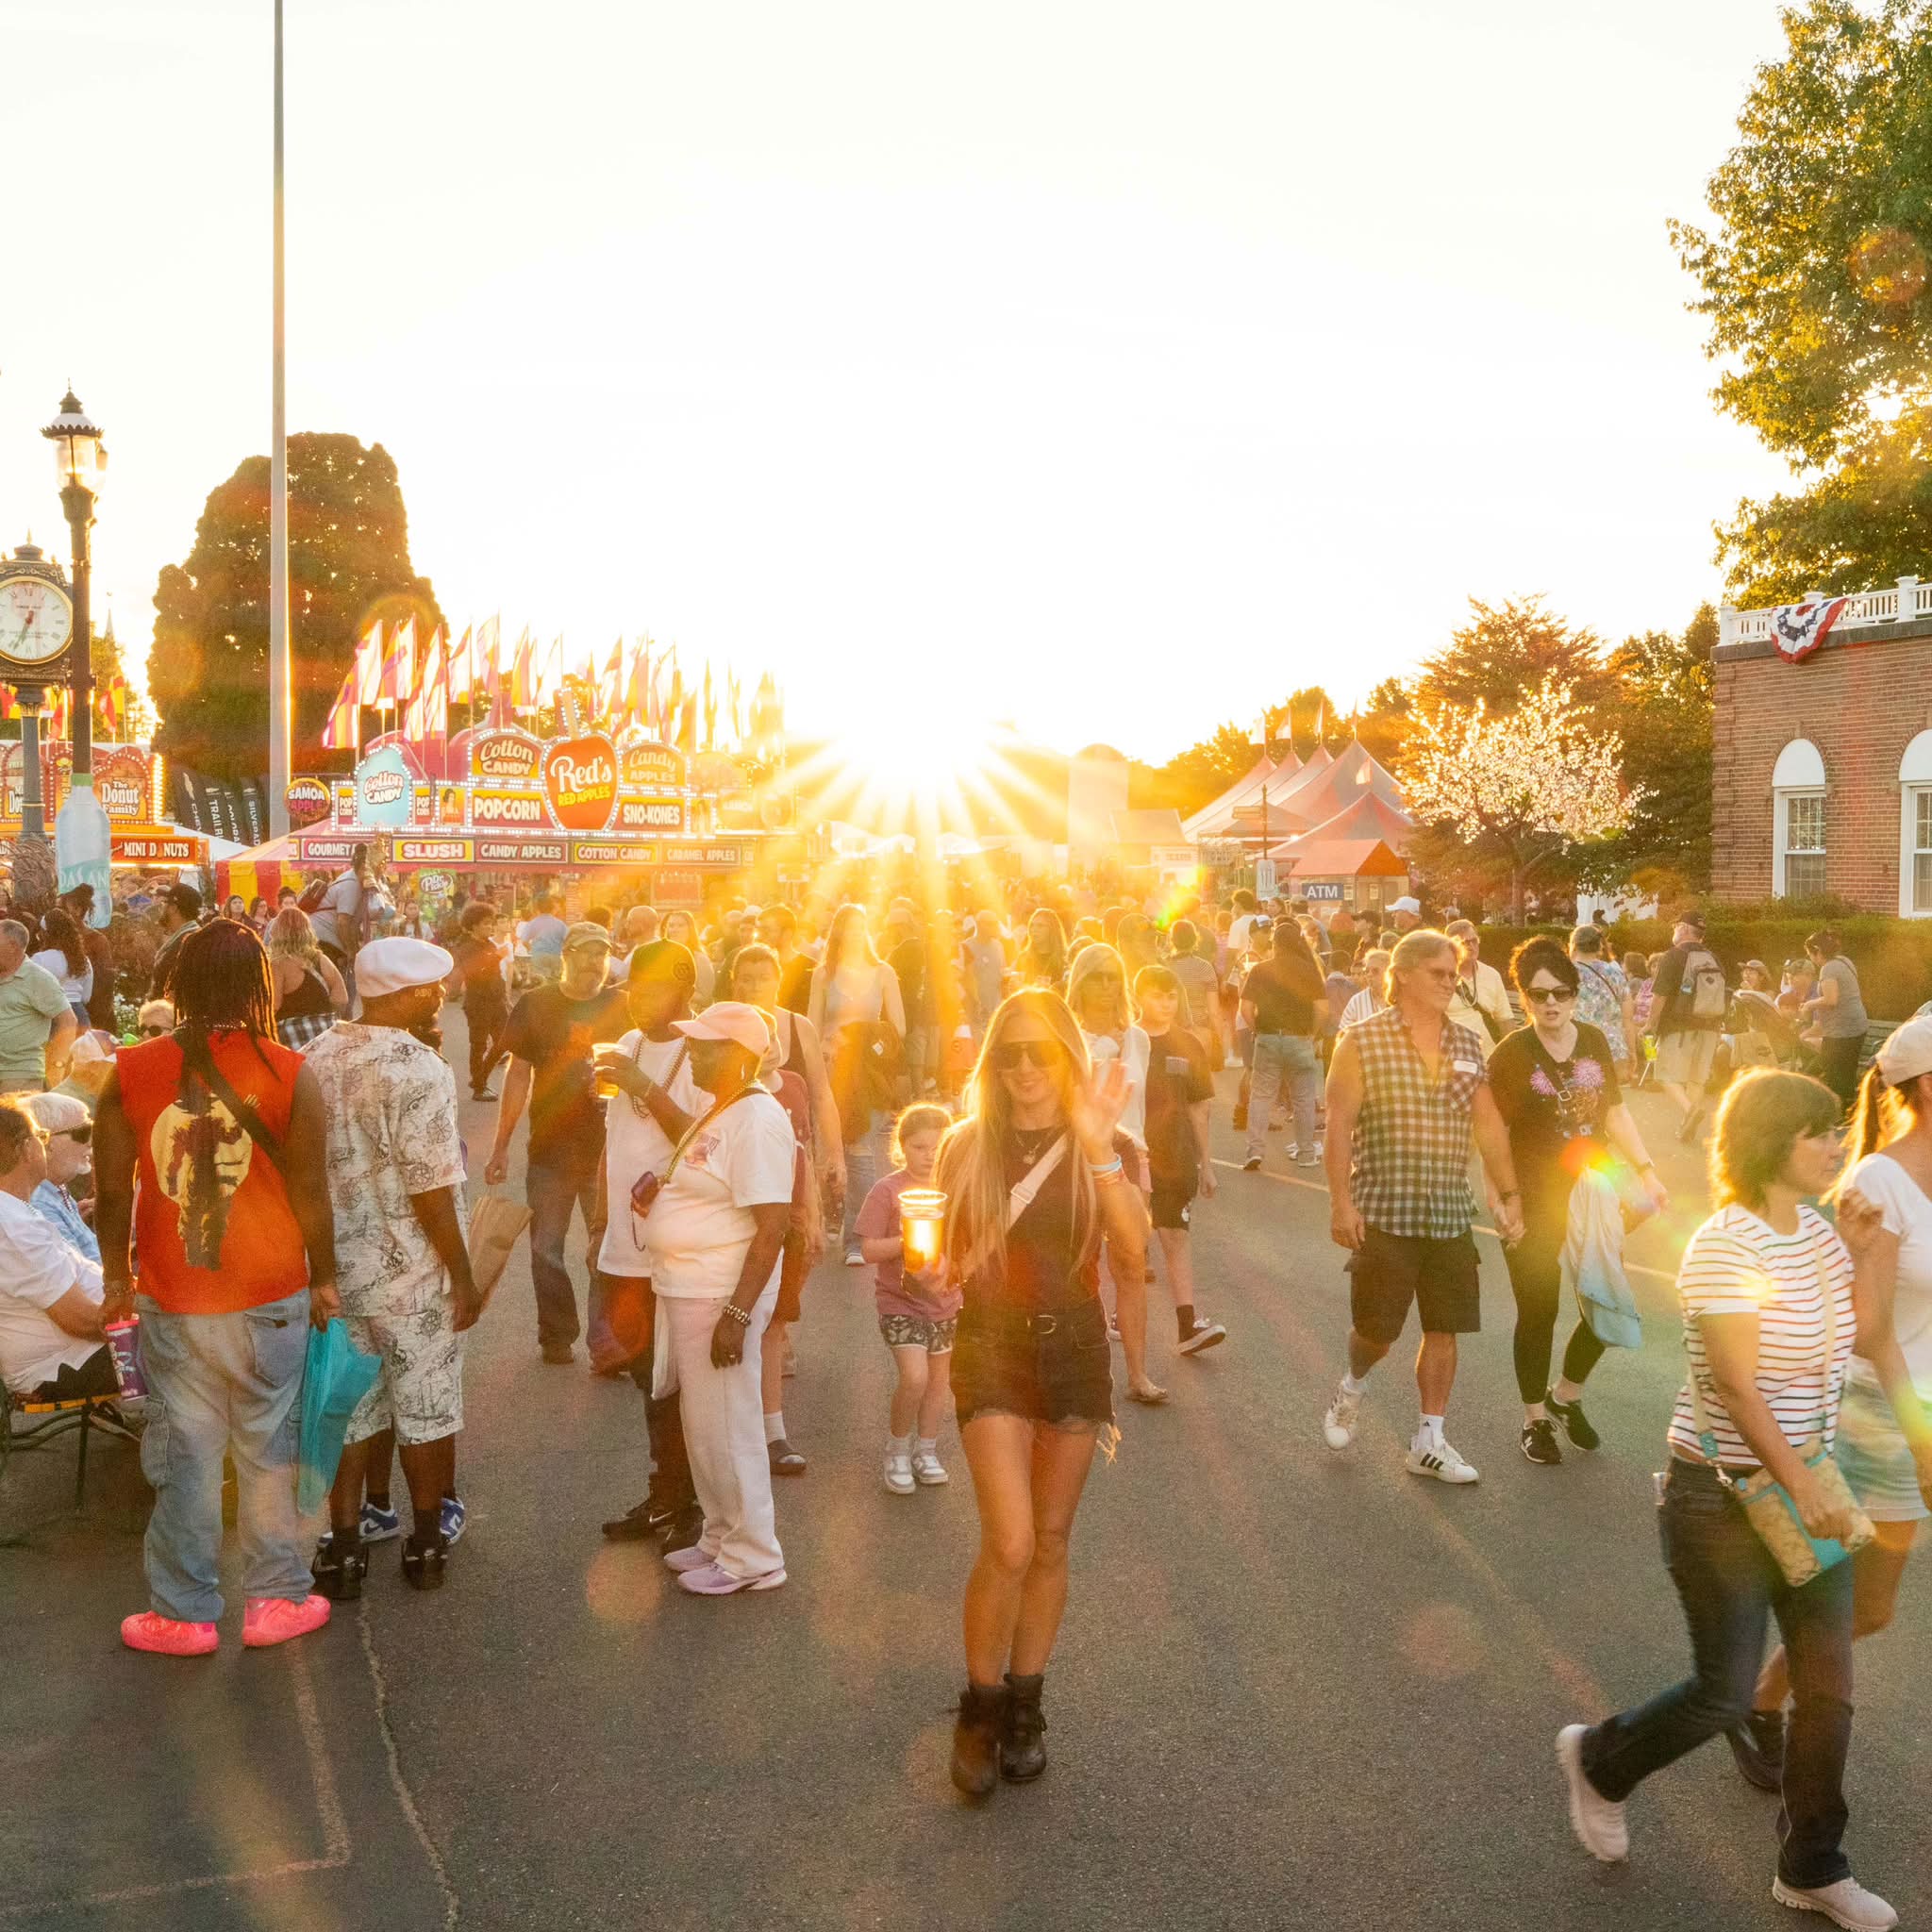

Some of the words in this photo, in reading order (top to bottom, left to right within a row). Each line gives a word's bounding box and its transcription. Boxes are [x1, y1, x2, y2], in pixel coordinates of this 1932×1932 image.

[480, 740, 534, 762] Cotton
[482, 760, 532, 775] CANDY
[629, 750, 676, 773] Candy
[550, 756, 612, 792] Red's
[629, 769, 676, 782] APPLES
[112, 780, 128, 790] The
[364, 772, 405, 794] Cotton
[101, 782, 140, 805] Donut
[366, 786, 403, 804] CANDY
[558, 792, 576, 807] RED
[577, 786, 611, 804] APPLES
[339, 797, 353, 808] POP
[416, 796, 430, 808] POP
[475, 797, 541, 821] POPCORN
[102, 804, 140, 816] Family
[623, 805, 680, 824] SNO-KONES
[124, 842, 146, 857] MINI
[308, 843, 351, 857] GOURMET
[403, 843, 464, 858] SLUSH
[481, 844, 518, 858] CANDY
[521, 845, 562, 859] APPLES
[578, 846, 617, 859] COTTON
[620, 847, 652, 860] CANDY
[667, 849, 705, 861] CARAMEL
[707, 850, 736, 861] APPLES
[1307, 885, 1338, 897] ATM
